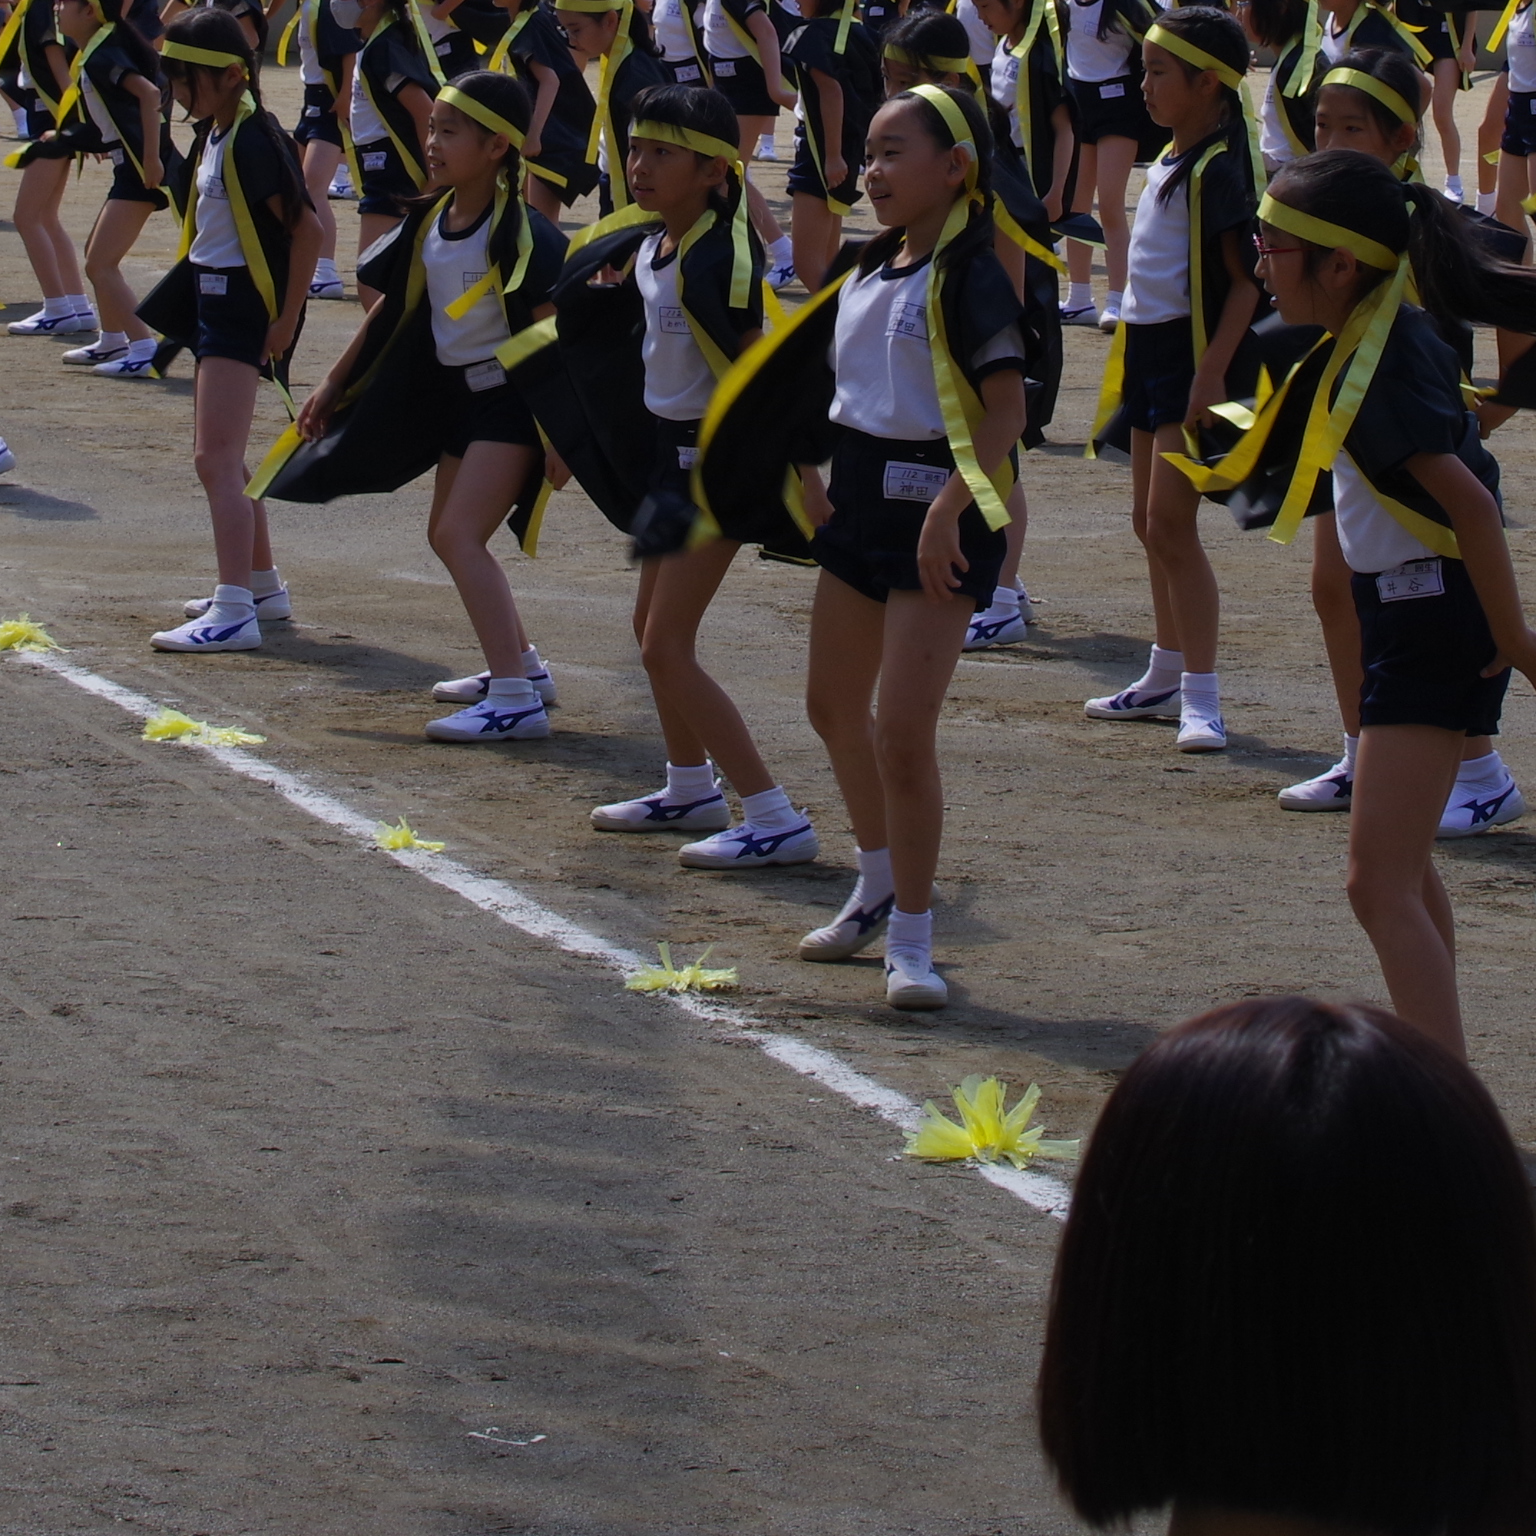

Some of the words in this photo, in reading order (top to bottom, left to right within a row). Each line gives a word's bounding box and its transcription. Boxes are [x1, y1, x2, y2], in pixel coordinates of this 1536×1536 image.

[901, 470, 918, 479] 112
[924, 473, 941, 482] 回生
[899, 481, 928, 496] 神田
[1414, 563, 1434, 573] 回生
[1387, 577, 1424, 595] 井谷
